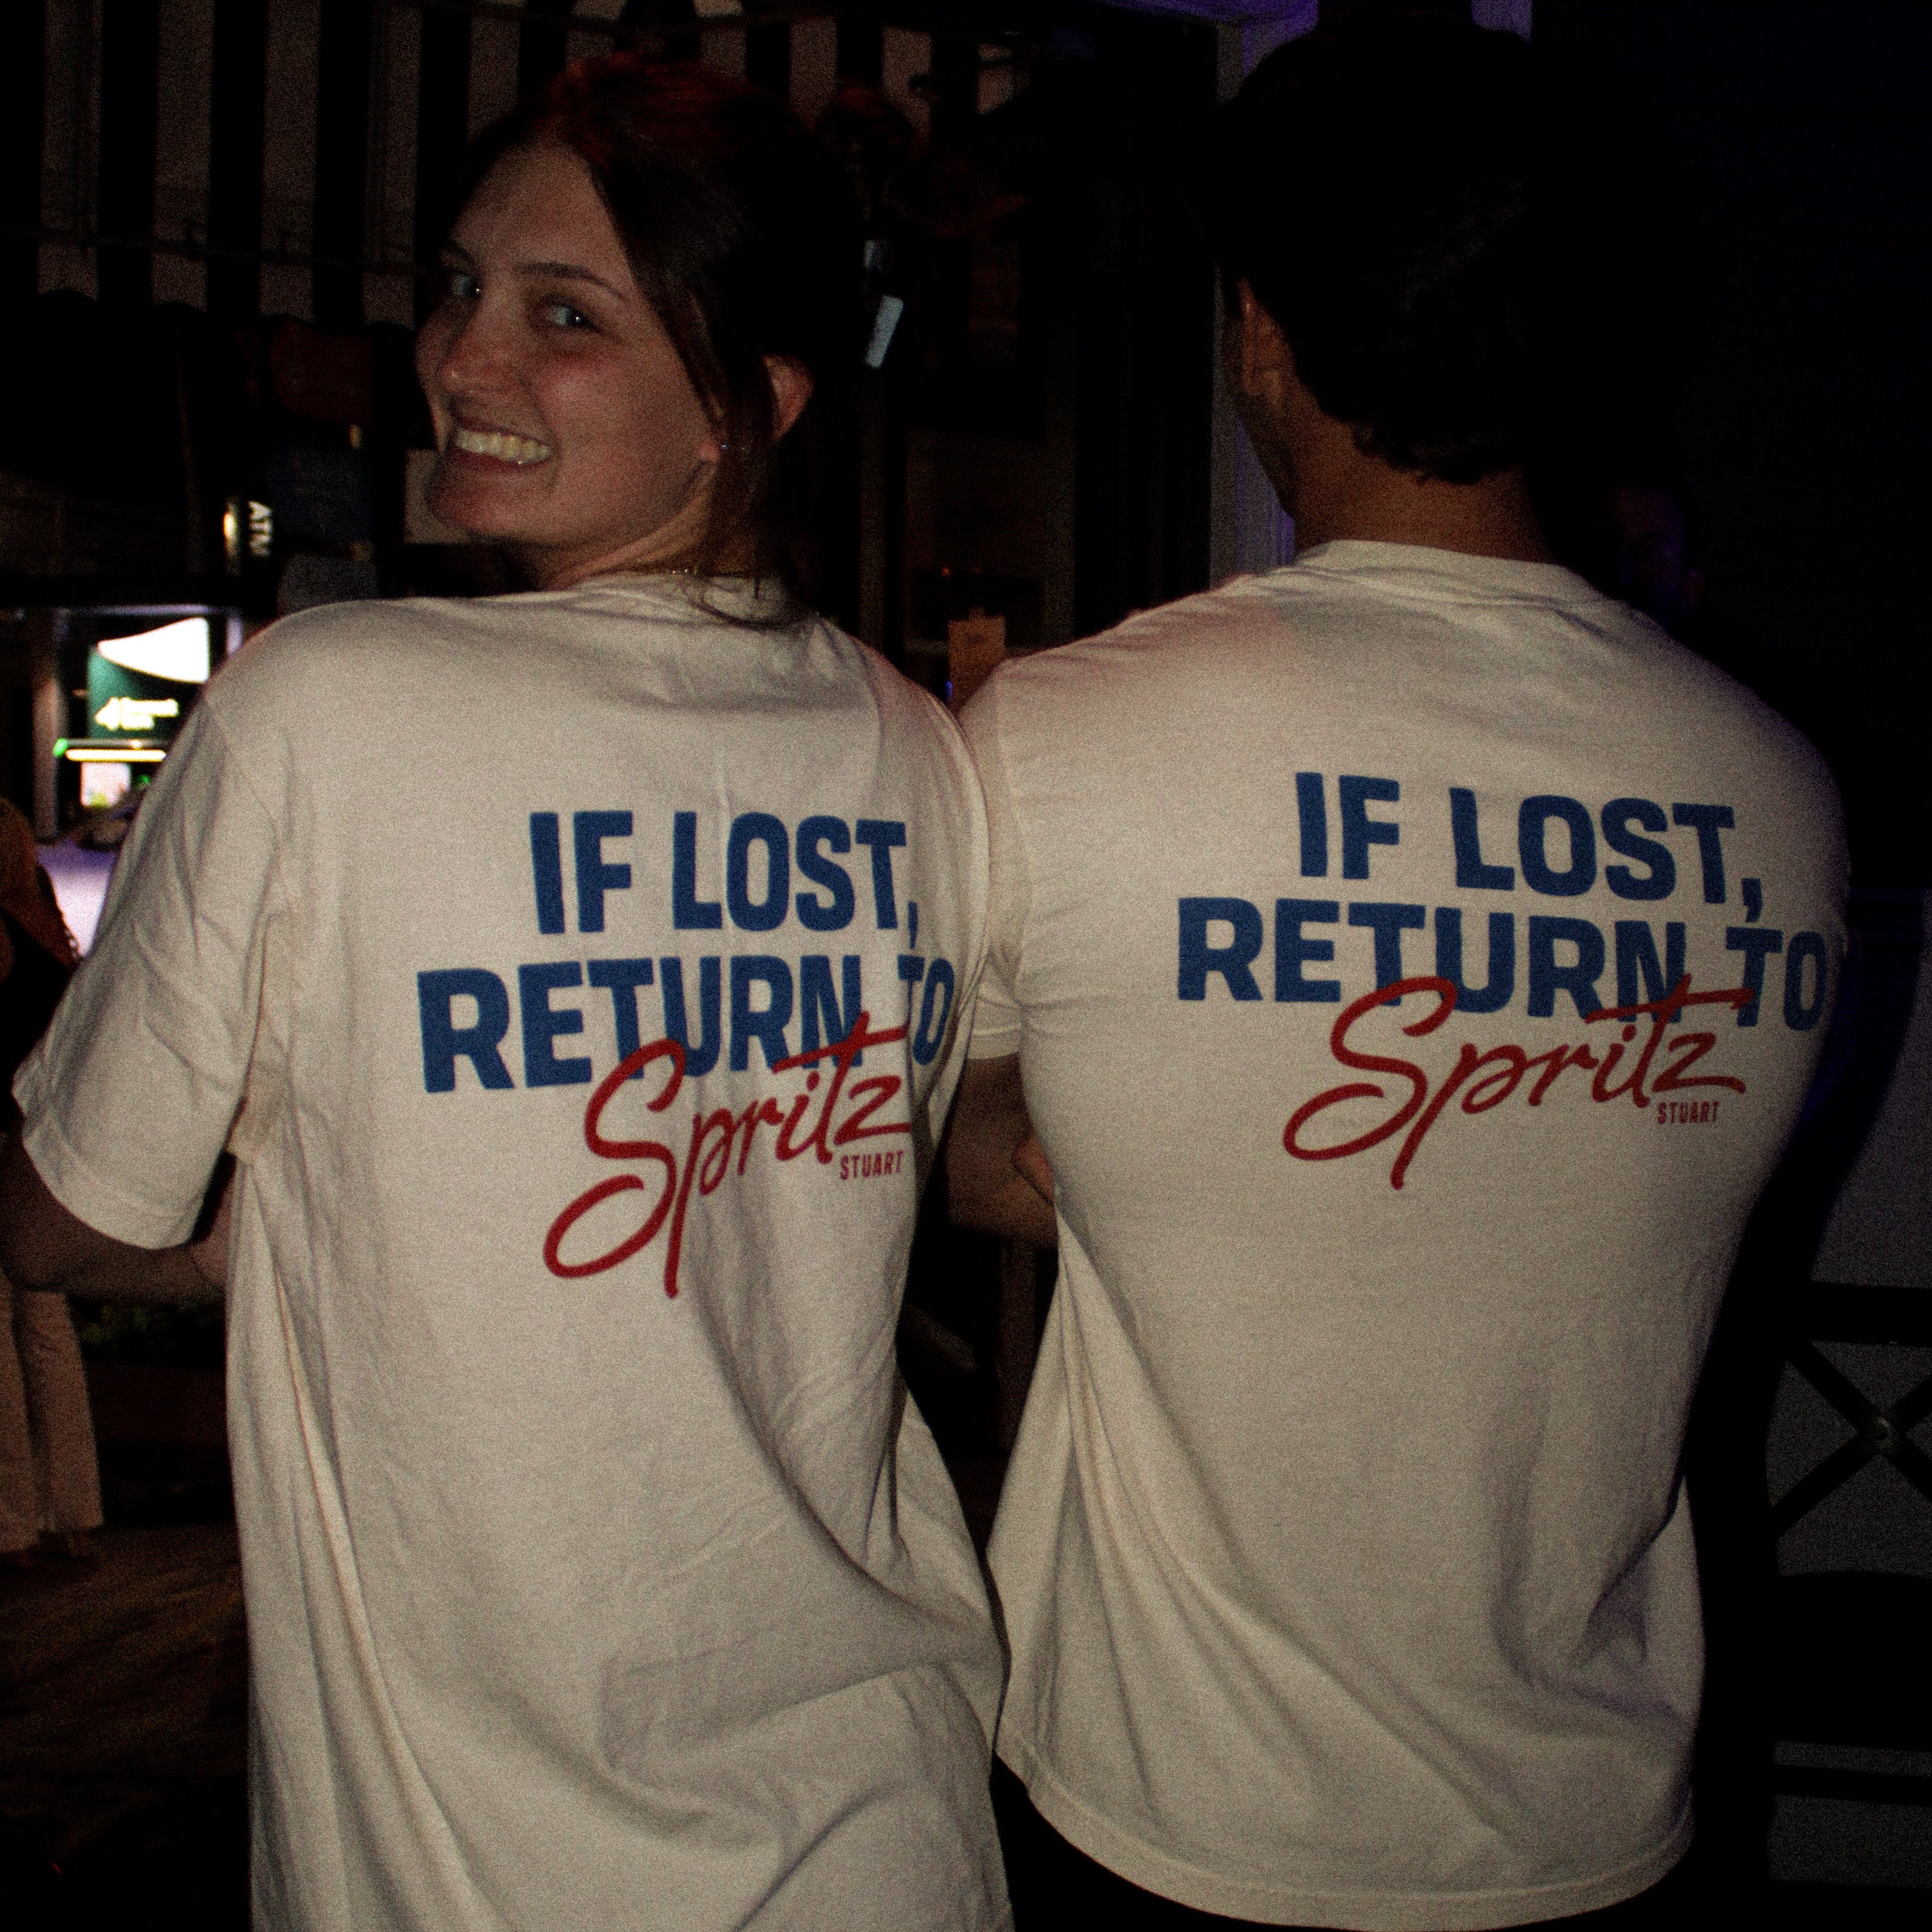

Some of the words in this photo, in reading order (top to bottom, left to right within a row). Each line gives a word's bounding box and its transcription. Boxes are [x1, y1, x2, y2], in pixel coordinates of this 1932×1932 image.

[247, 499, 274, 558] ATM
[529, 811, 632, 934] IF
[673, 812, 918, 949] LOST,
[1296, 772, 1400, 879] IF
[1449, 787, 1763, 922] LOST,
[417, 954, 863, 1092] RETURN
[897, 954, 954, 1065] TO
[1178, 897, 1685, 1024] RETURN
[1726, 926, 1827, 1030] TO
[1284, 974, 1755, 1189] Spritz
[1658, 1101, 1719, 1124] STUART
[543, 1012, 911, 1298] Spritz
[840, 1150, 904, 1180] STUART
